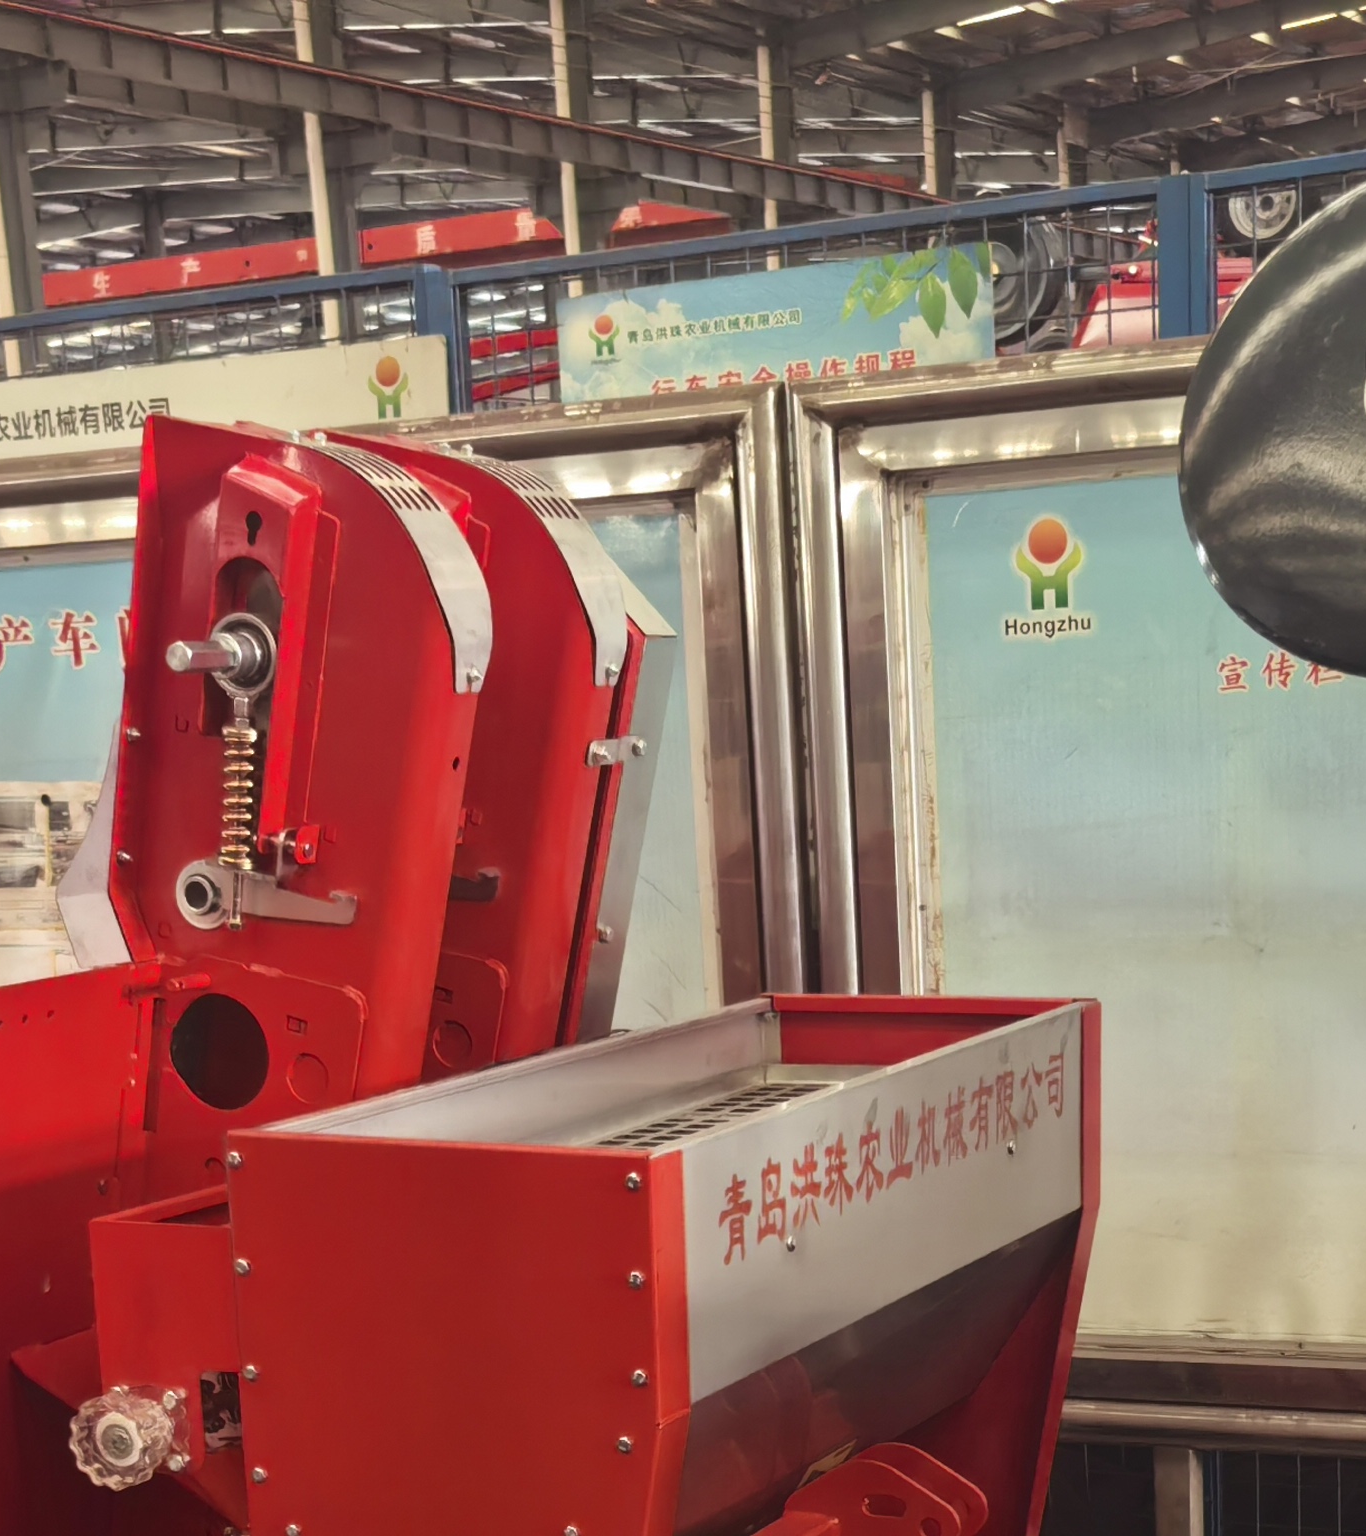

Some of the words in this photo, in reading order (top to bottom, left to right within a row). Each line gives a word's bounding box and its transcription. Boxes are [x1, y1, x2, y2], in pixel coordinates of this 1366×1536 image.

[1004, 616, 1092, 638] Hongzhu
[718, 1052, 1066, 1265] 青岛洪珠农业机械有限公司
